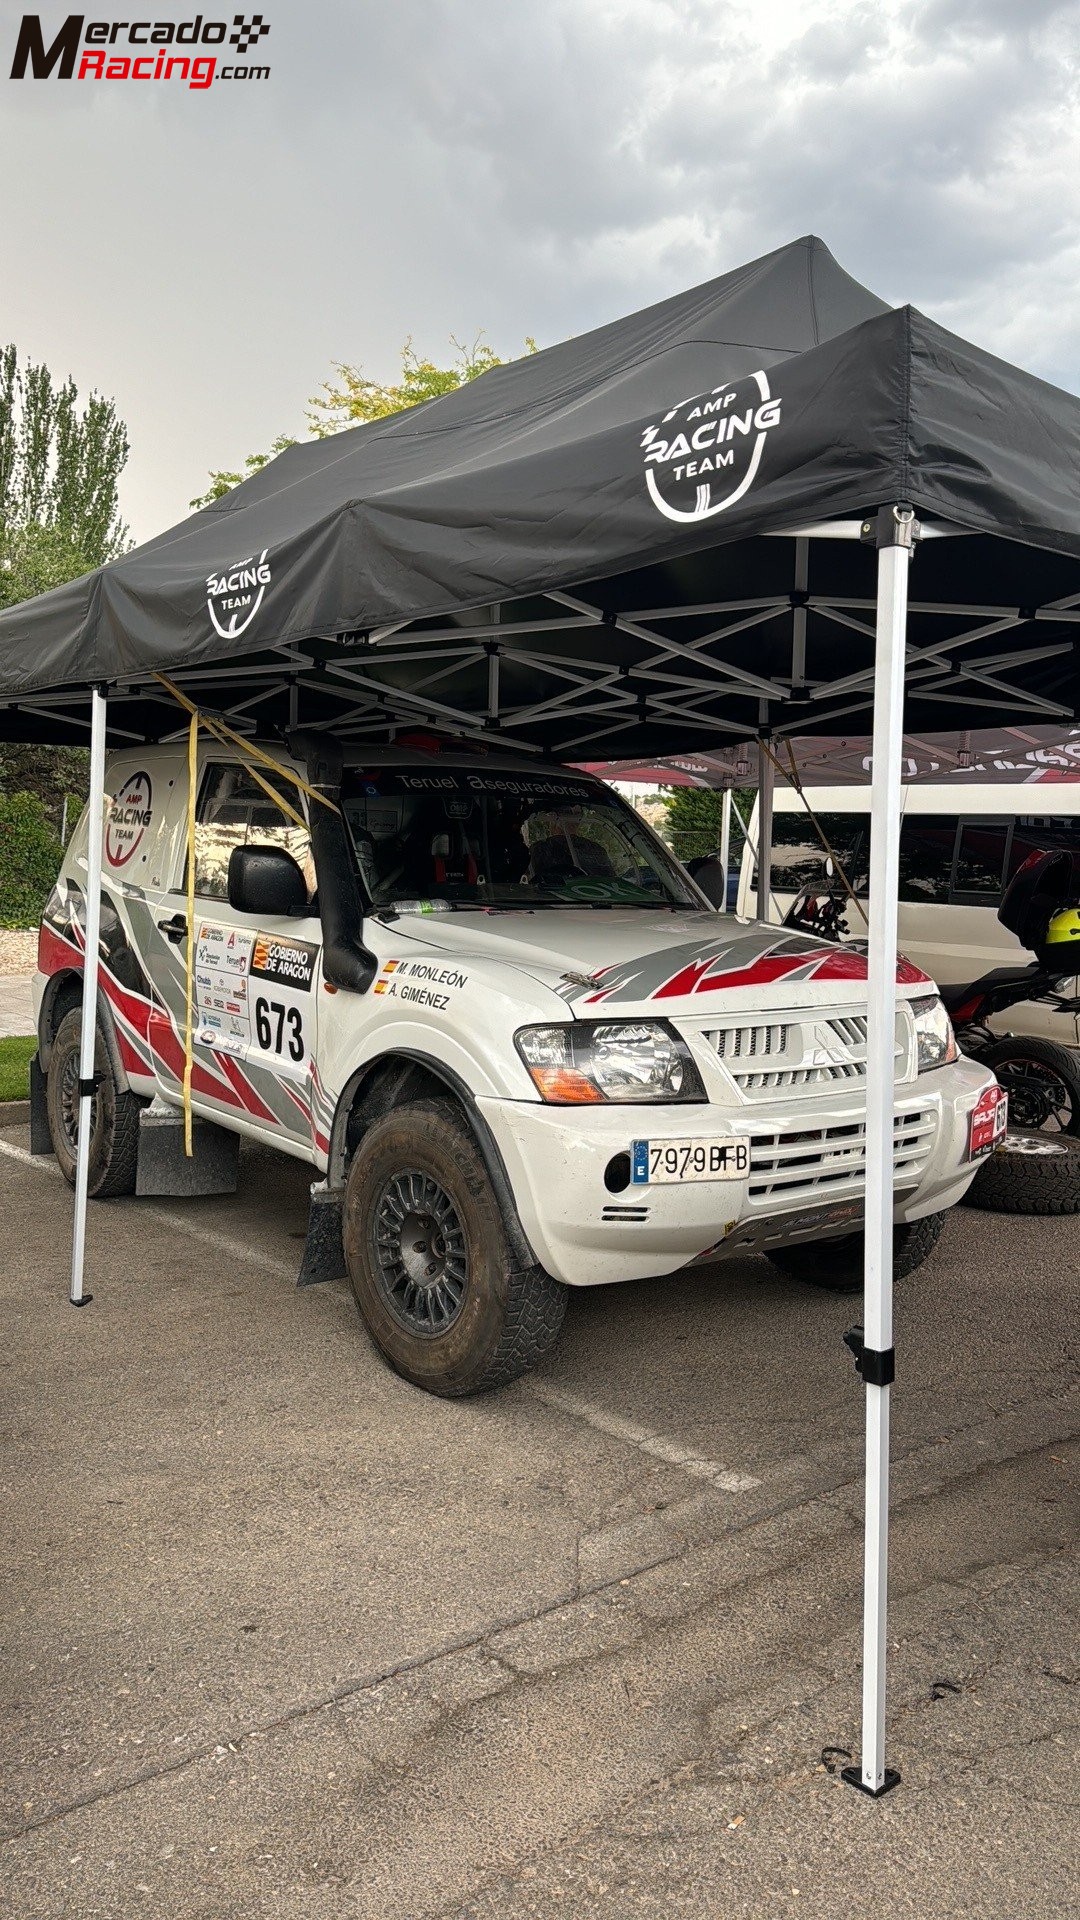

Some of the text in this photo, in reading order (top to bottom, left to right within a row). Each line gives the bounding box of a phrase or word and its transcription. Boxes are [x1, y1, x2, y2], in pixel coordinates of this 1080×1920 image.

[686, 393, 737, 422] AMP
[644, 398, 782, 464] RACING
[673, 450, 734, 481] TEAM
[206, 564, 271, 596] RACING
[221, 594, 252, 611] TEAM
[395, 775, 459, 790] Teruel
[126, 794, 143, 805] AMP
[110, 807, 153, 827] RACING
[115, 828, 134, 841] TEAM
[266, 957, 278, 972] DE
[270, 944, 308, 965] GOBIERNO
[396, 962, 468, 988] M. MONLEÓN
[388, 983, 450, 1010] A. GIMÉNEZ
[255, 996, 305, 1062] 673
[637, 1145, 747, 1178] E 7979 BFB
